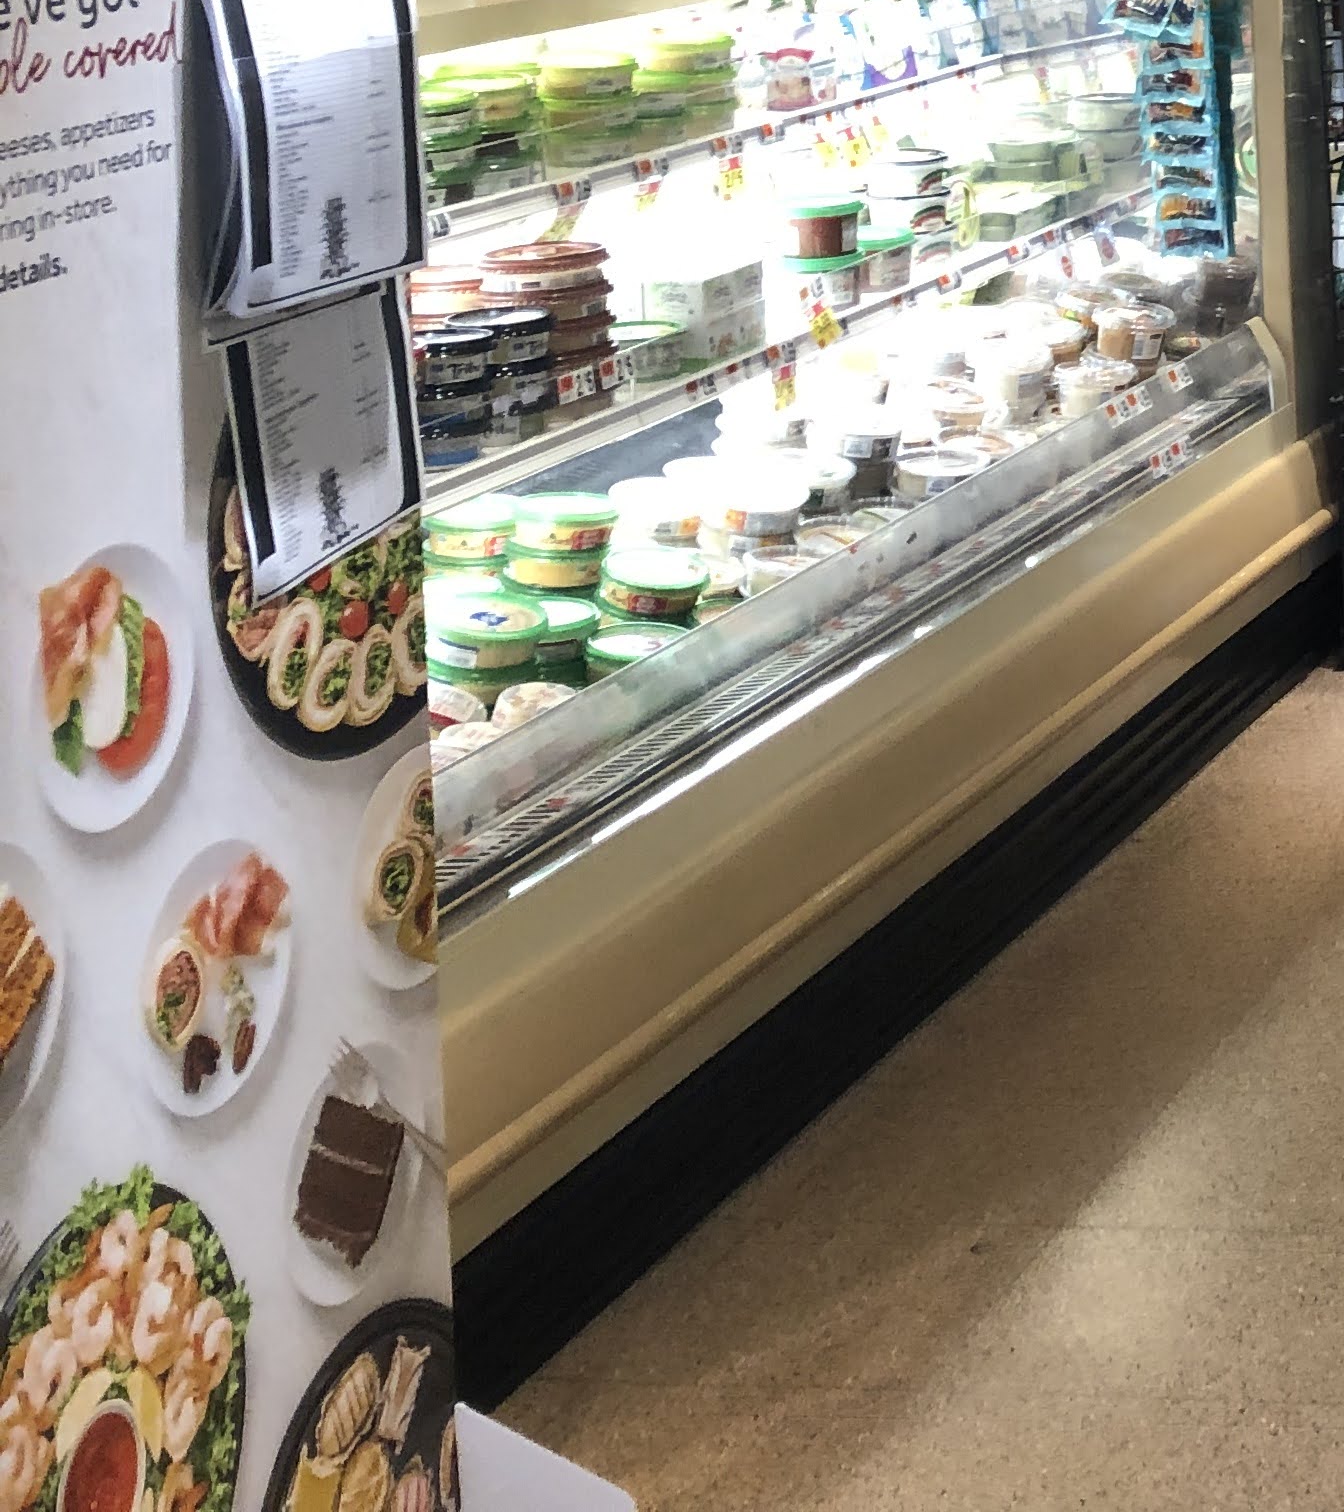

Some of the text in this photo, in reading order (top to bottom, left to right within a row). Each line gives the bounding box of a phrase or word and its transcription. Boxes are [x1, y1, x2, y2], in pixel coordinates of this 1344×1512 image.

[63, 0, 181, 80] covered
[59, 106, 157, 147] appetizers
[61, 161, 96, 194] you
[97, 142, 145, 176] need
[142, 138, 173, 168] for
[38, 192, 118, 232] in-store.
